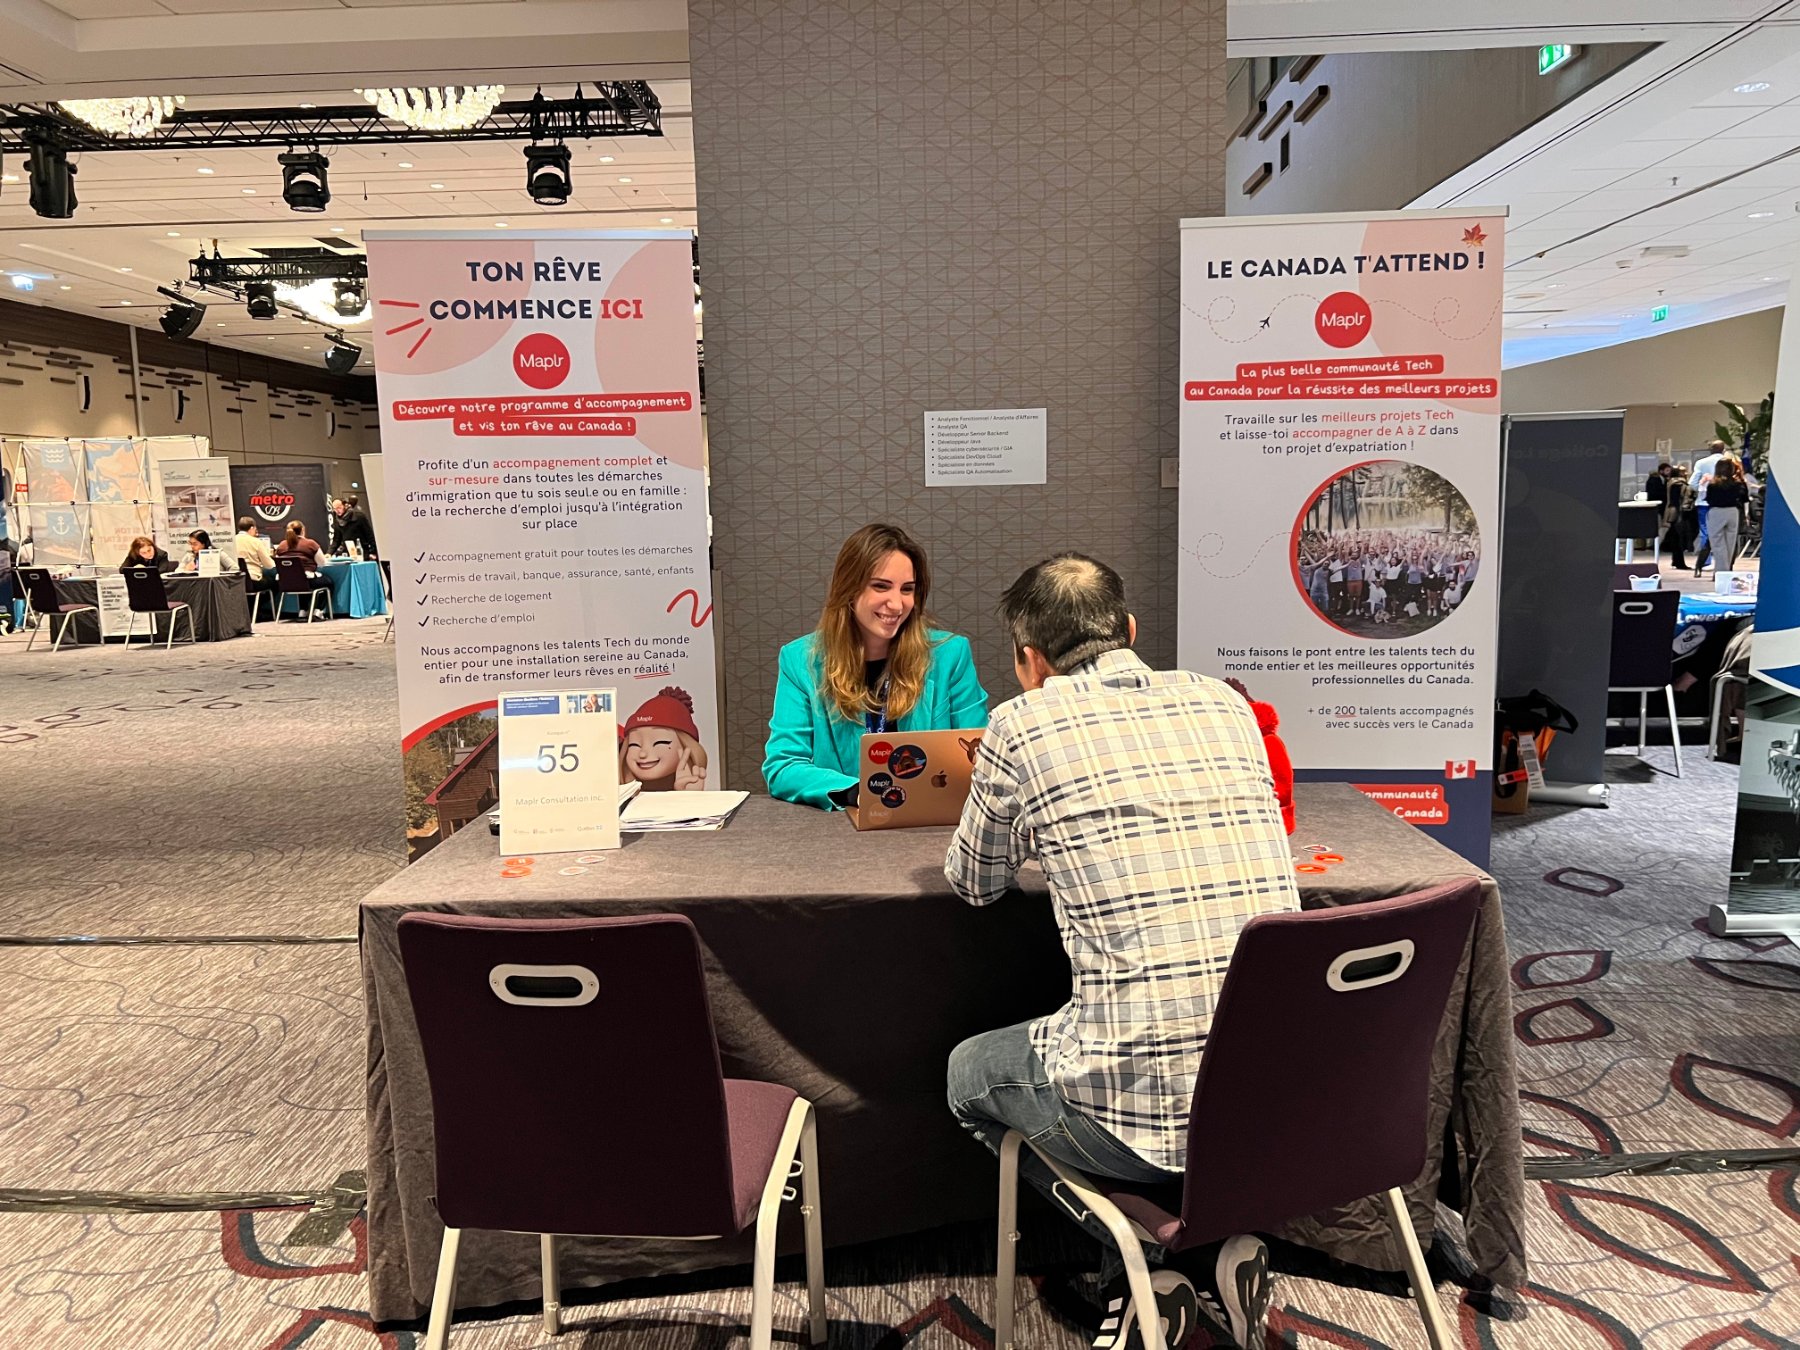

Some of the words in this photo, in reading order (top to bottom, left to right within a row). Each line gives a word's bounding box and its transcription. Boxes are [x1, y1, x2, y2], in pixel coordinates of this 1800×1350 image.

[466, 262, 523, 281] TON
[534, 256, 601, 281] RÊVE
[1208, 260, 1232, 278] LE
[1241, 256, 1346, 277] CANADA
[1354, 252, 1468, 273] T'ATTEND
[1478, 251, 1484, 269] !
[429, 298, 592, 320] COMMENCE
[601, 299, 642, 320] ICI
[1322, 313, 1365, 328] Maplr
[520, 354, 563, 370] Maplr
[1241, 368, 1257, 378] La
[1262, 367, 1285, 380] plus
[1291, 364, 1321, 376] belle
[1327, 360, 1400, 374] communauté
[1405, 359, 1433, 371] Tech
[1190, 387, 1204, 396] au
[1208, 386, 1252, 396] Canada
[1257, 386, 1283, 398] pour
[1288, 384, 1301, 395] la
[1306, 384, 1355, 395] réussite
[1360, 383, 1380, 395] des
[1386, 383, 1440, 394] meilleurs
[1445, 383, 1491, 397] projets
[398, 404, 455, 415] Découvre
[461, 403, 495, 412] notre
[500, 401, 568, 413] programme
[574, 396, 685, 409] d'accompagnement
[1224, 414, 1274, 424] Travaille
[1278, 415, 1298, 423] sur
[1301, 413, 1317, 422] les
[1321, 412, 1375, 422] meilleurs
[1380, 412, 1420, 423] projets
[1425, 409, 1453, 419] Tech
[459, 421, 473, 431] et
[479, 422, 494, 431] vis
[500, 421, 520, 431] ton
[525, 420, 553, 430] rêve
[578, 420, 622, 430] Canada
[1219, 431, 1231, 440] et
[1235, 428, 1288, 439] laisse-toi
[1292, 429, 1372, 439] accompagner
[1377, 426, 1391, 435] de
[1395, 425, 1403, 435] A
[1407, 426, 1413, 435] à
[1418, 425, 1425, 435] Z
[1430, 425, 1458, 435] dans
[1262, 445, 1281, 454] ton
[1286, 443, 1321, 455] projet
[1325, 441, 1406, 454] d'expatriation
[418, 459, 458, 470] Profite
[462, 458, 488, 469] d'un
[493, 457, 600, 470] accompagnement
[604, 456, 652, 468] complet
[656, 455, 667, 465] et
[429, 476, 498, 485] sur-mesure
[503, 473, 531, 483] dans
[535, 473, 573, 482] toutes
[577, 472, 593, 481] les
[597, 471, 662, 481] démarches
[251, 494, 295, 505] metro
[406, 489, 490, 503] d'immigration
[495, 491, 517, 501] que
[521, 489, 533, 498] tu
[537, 487, 560, 498] sois
[565, 487, 598, 497] seul.e
[602, 488, 617, 496] ou
[621, 488, 635, 496] en
[640, 485, 680, 495] famille
[411, 507, 426, 517] de
[430, 506, 440, 516] la
[445, 505, 506, 515] recherche
[510, 503, 562, 516] d'emploi
[566, 501, 607, 515] jusqu'à
[612, 501, 682, 513] l'intégration
[522, 521, 541, 529] sur
[545, 519, 577, 531] place
[428, 551, 521, 562] Accompagnement
[524, 550, 557, 561] gratuit
[561, 550, 583, 559] pour
[587, 548, 618, 556] toutes
[621, 547, 635, 555] les
[638, 545, 692, 554] démarches
[430, 573, 465, 582] Permis
[468, 573, 481, 581] de
[484, 571, 519, 581] travail,
[523, 571, 563, 580] banque,
[567, 570, 621, 578] assurance,
[624, 568, 654, 576] santé,
[657, 566, 693, 575] enfants
[431, 594, 485, 604] Recherche
[489, 593, 501, 602] de
[504, 591, 551, 603] logement
[433, 615, 487, 625] Recherche
[490, 613, 534, 623] d'emploi
[421, 646, 450, 655] Nous
[453, 643, 539, 654] accompagnons
[543, 641, 559, 650] les
[562, 639, 600, 649] talents
[604, 637, 630, 647] Tech
[634, 637, 647, 646] du
[652, 635, 689, 644] monde
[1217, 647, 1245, 656] Nous
[1249, 647, 1288, 656] faisons
[1292, 647, 1301, 656] le
[1306, 648, 1331, 658] pont
[1335, 647, 1365, 655] entre
[1369, 646, 1384, 655] les
[1389, 646, 1427, 655] talents
[1431, 646, 1456, 655] tech
[1460, 646, 1474, 655] du
[424, 661, 457, 670] entier
[461, 660, 488, 670] pour
[492, 658, 513, 666] une
[517, 654, 579, 665] installation
[583, 652, 623, 662] sereine
[644, 649, 688, 659] Canada,
[1225, 661, 1263, 670] monde
[1266, 661, 1300, 670] entier
[1303, 662, 1314, 670] et
[1318, 661, 1333, 670] les
[1337, 661, 1397, 670] meilleures
[1400, 660, 1474, 672] opportunités
[439, 673, 461, 683] afin
[465, 673, 479, 682] de
[482, 670, 549, 681] transformer
[554, 669, 581, 677] leurs
[585, 666, 613, 675] rêves
[634, 663, 668, 675] réalité
[1312, 674, 1404, 686] professionnelles
[1408, 675, 1422, 683] du
[1426, 674, 1473, 683] Canada.
[1318, 706, 1331, 714] de
[1335, 705, 1355, 716] 200
[1359, 706, 1396, 715] talents
[1399, 706, 1473, 717] accompagnés
[1353, 719, 1389, 728] succès
[1418, 720, 1428, 728] le
[1431, 719, 1473, 728] Canada
[538, 744, 579, 773] 55
[870, 780, 890, 788] Maplr
[540, 795, 589, 804] Consultation
[1393, 806, 1444, 819] Canada
